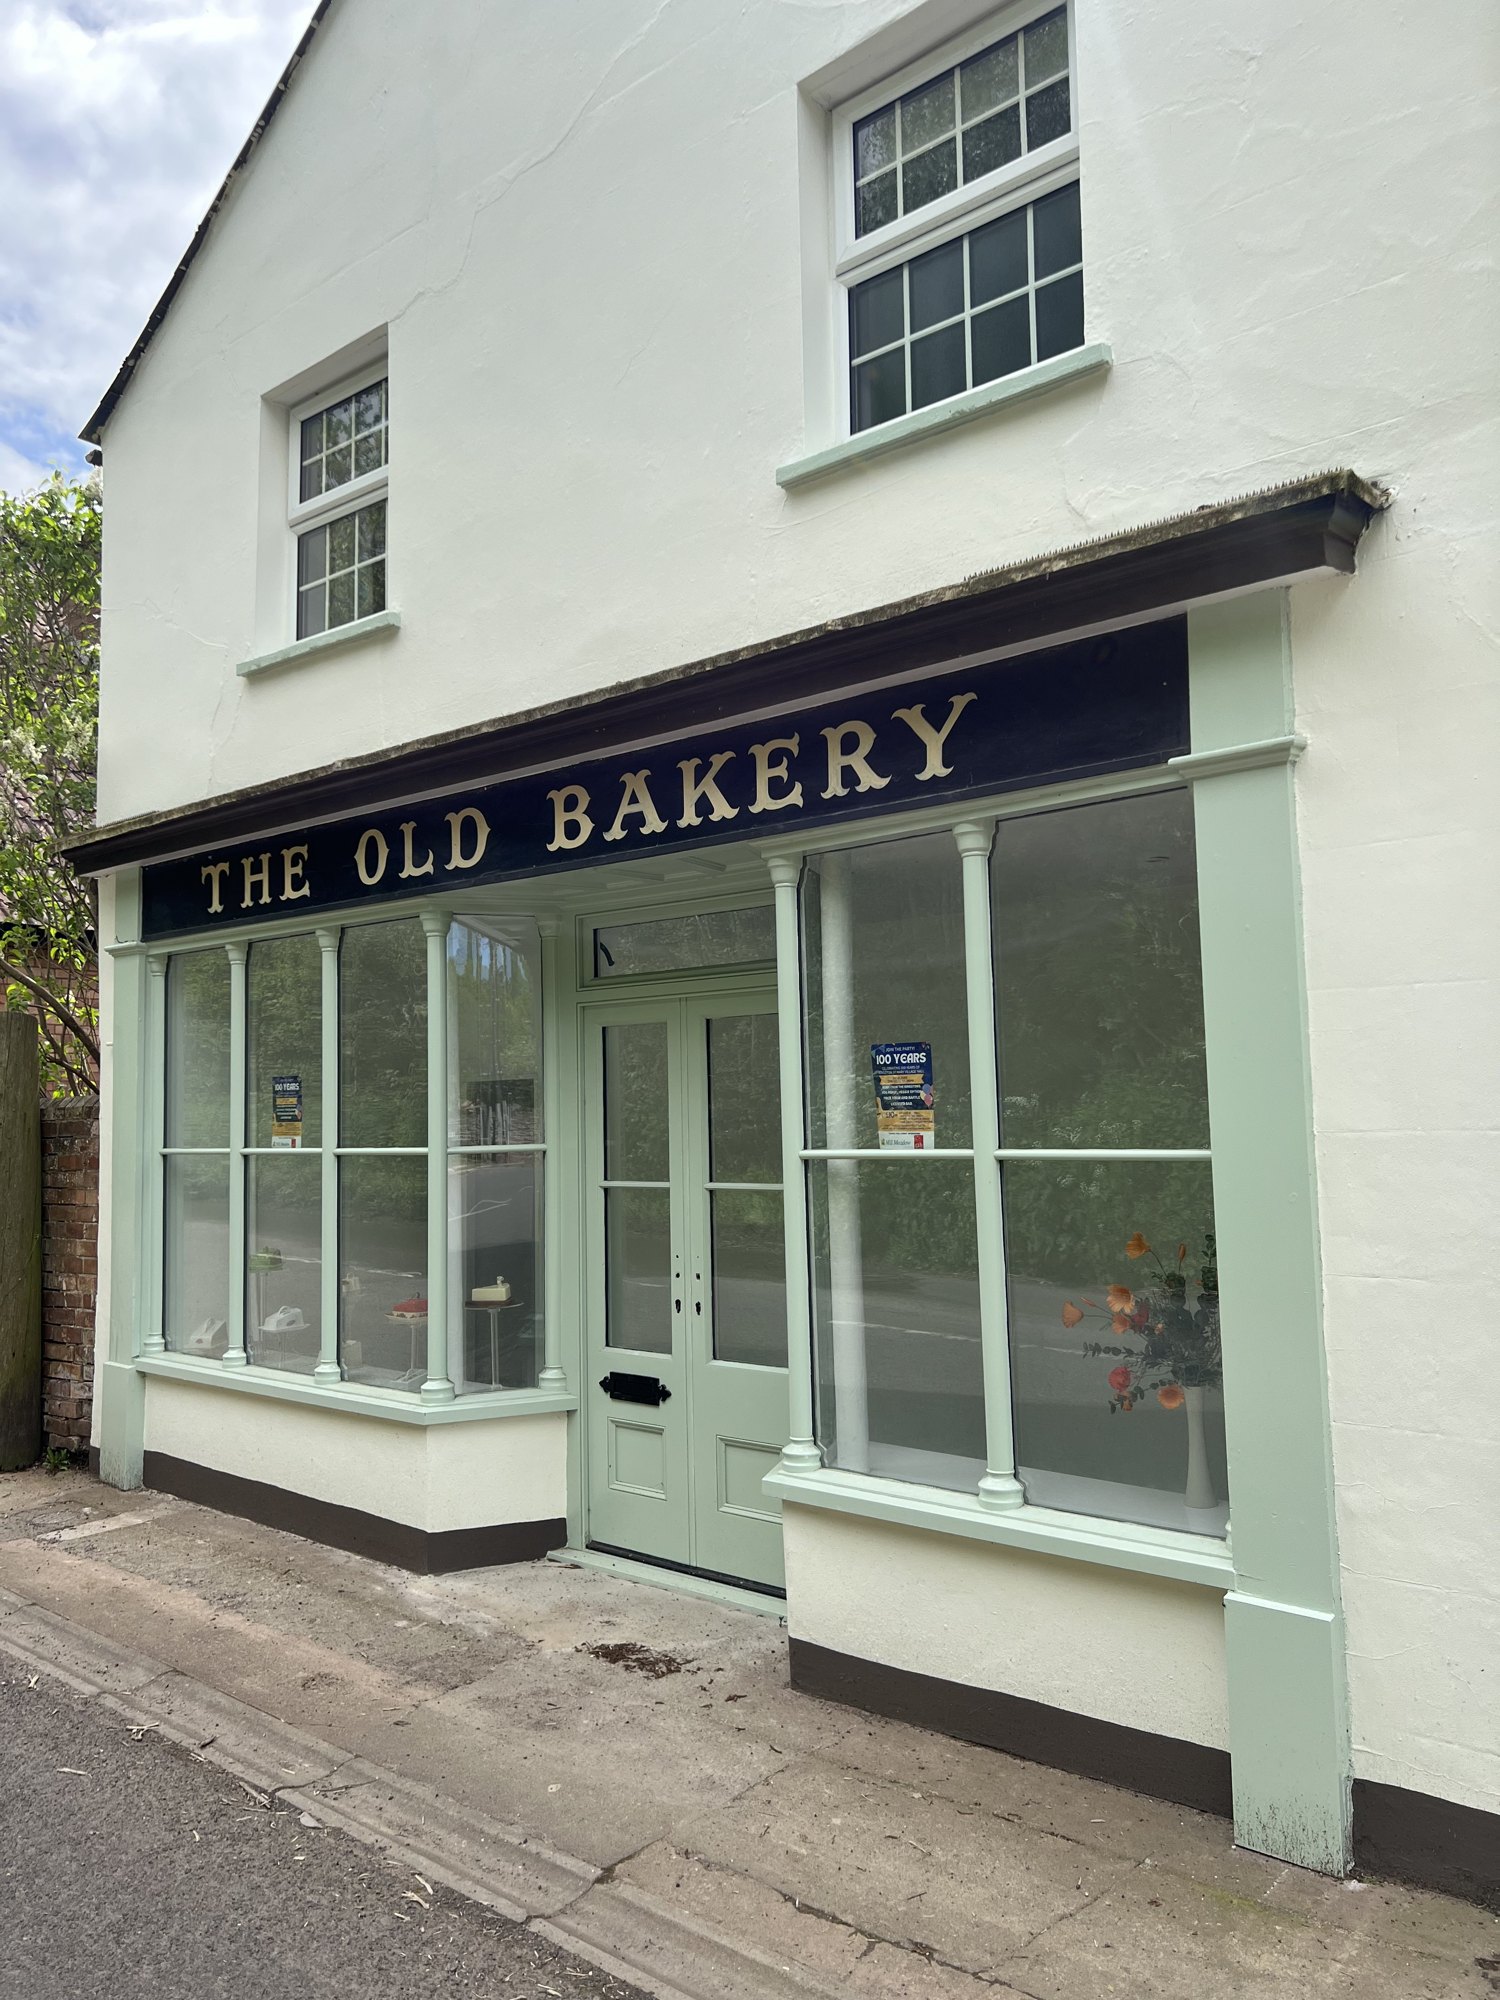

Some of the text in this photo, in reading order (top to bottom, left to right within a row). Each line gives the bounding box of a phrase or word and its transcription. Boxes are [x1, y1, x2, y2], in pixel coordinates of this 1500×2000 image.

[201, 692, 977, 912] THE OLD BAKERY
[876, 1052, 927, 1064] 100 YEARS
